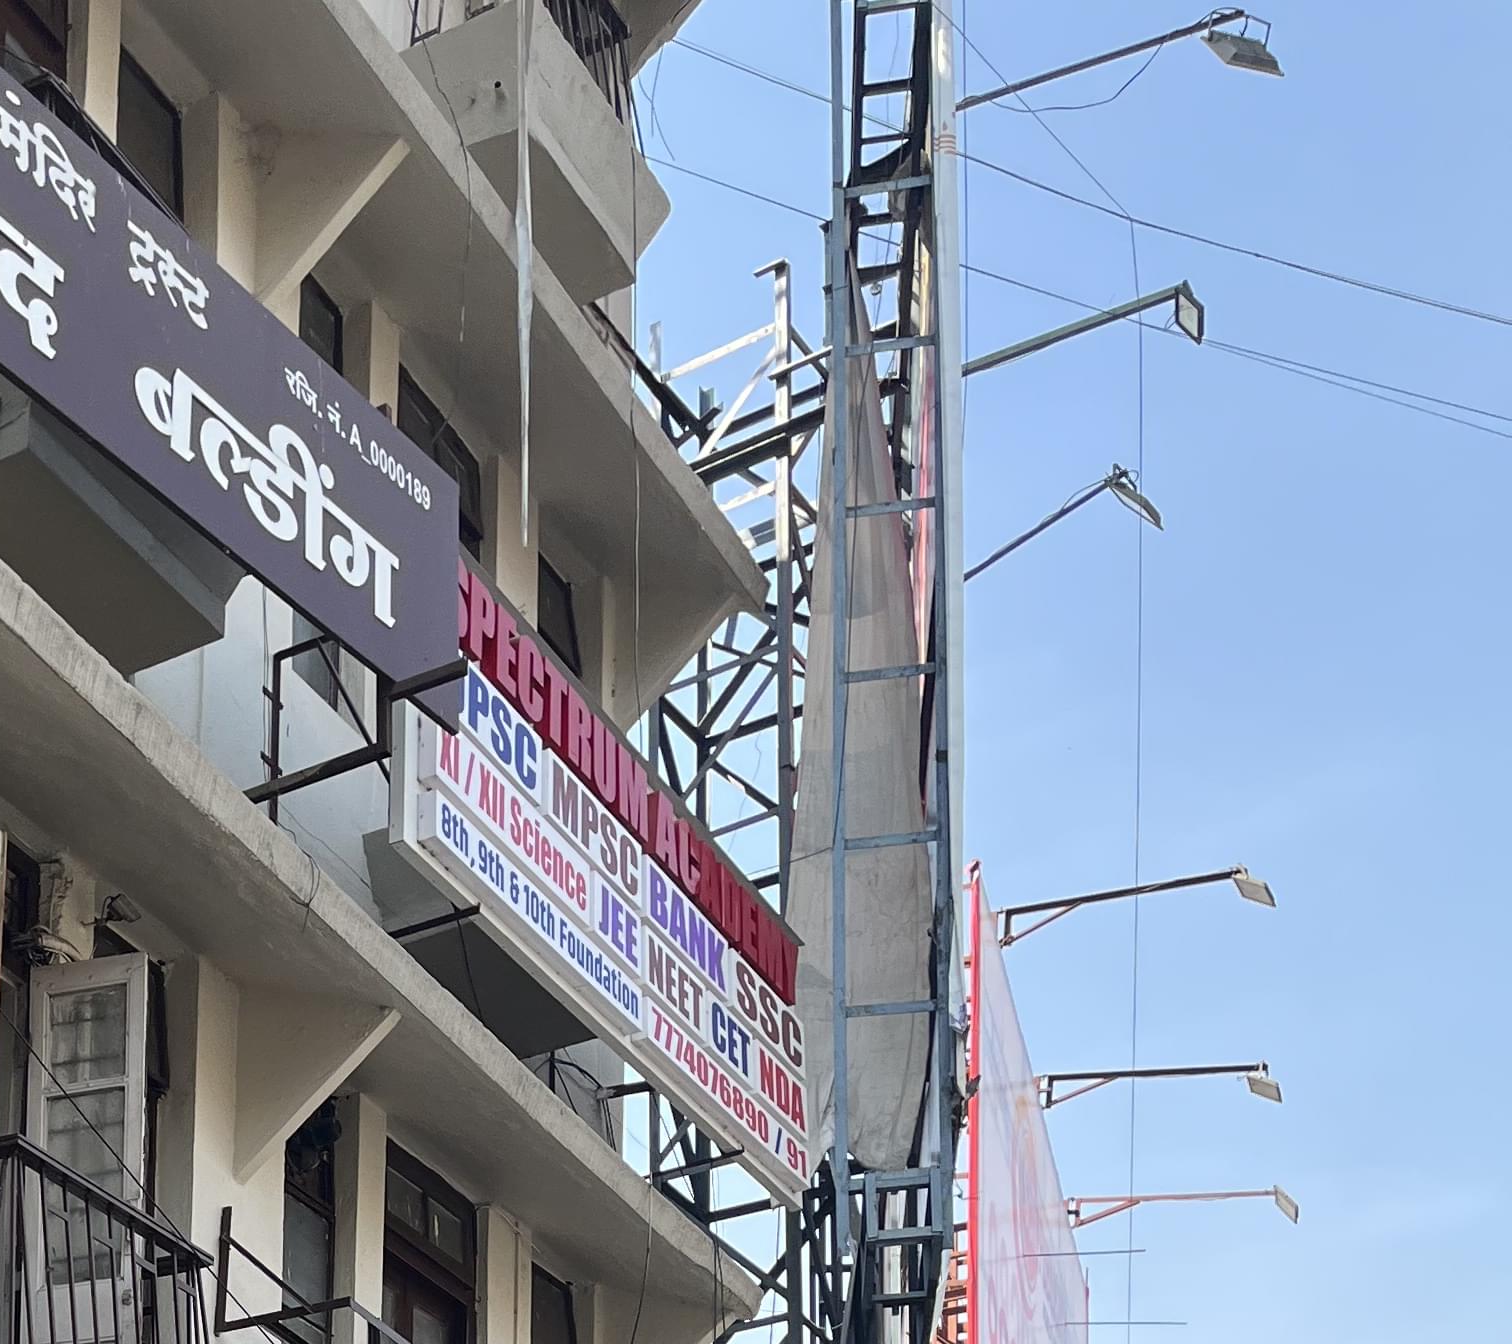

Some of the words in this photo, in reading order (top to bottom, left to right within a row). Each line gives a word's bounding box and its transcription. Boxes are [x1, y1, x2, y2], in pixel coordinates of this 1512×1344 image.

[458, 665, 538, 791] PSC
[552, 763, 639, 897] MPSC
[648, 863, 728, 994] BANK
[735, 959, 803, 1069] SSC
[510, 797, 588, 912] Science
[598, 884, 639, 968] JEE
[647, 935, 704, 1031] NEET
[711, 1001, 752, 1079] CET
[759, 1047, 807, 1133] NDA
[560, 922, 640, 1020] Foundation
[787, 1140, 809, 1180] 91
